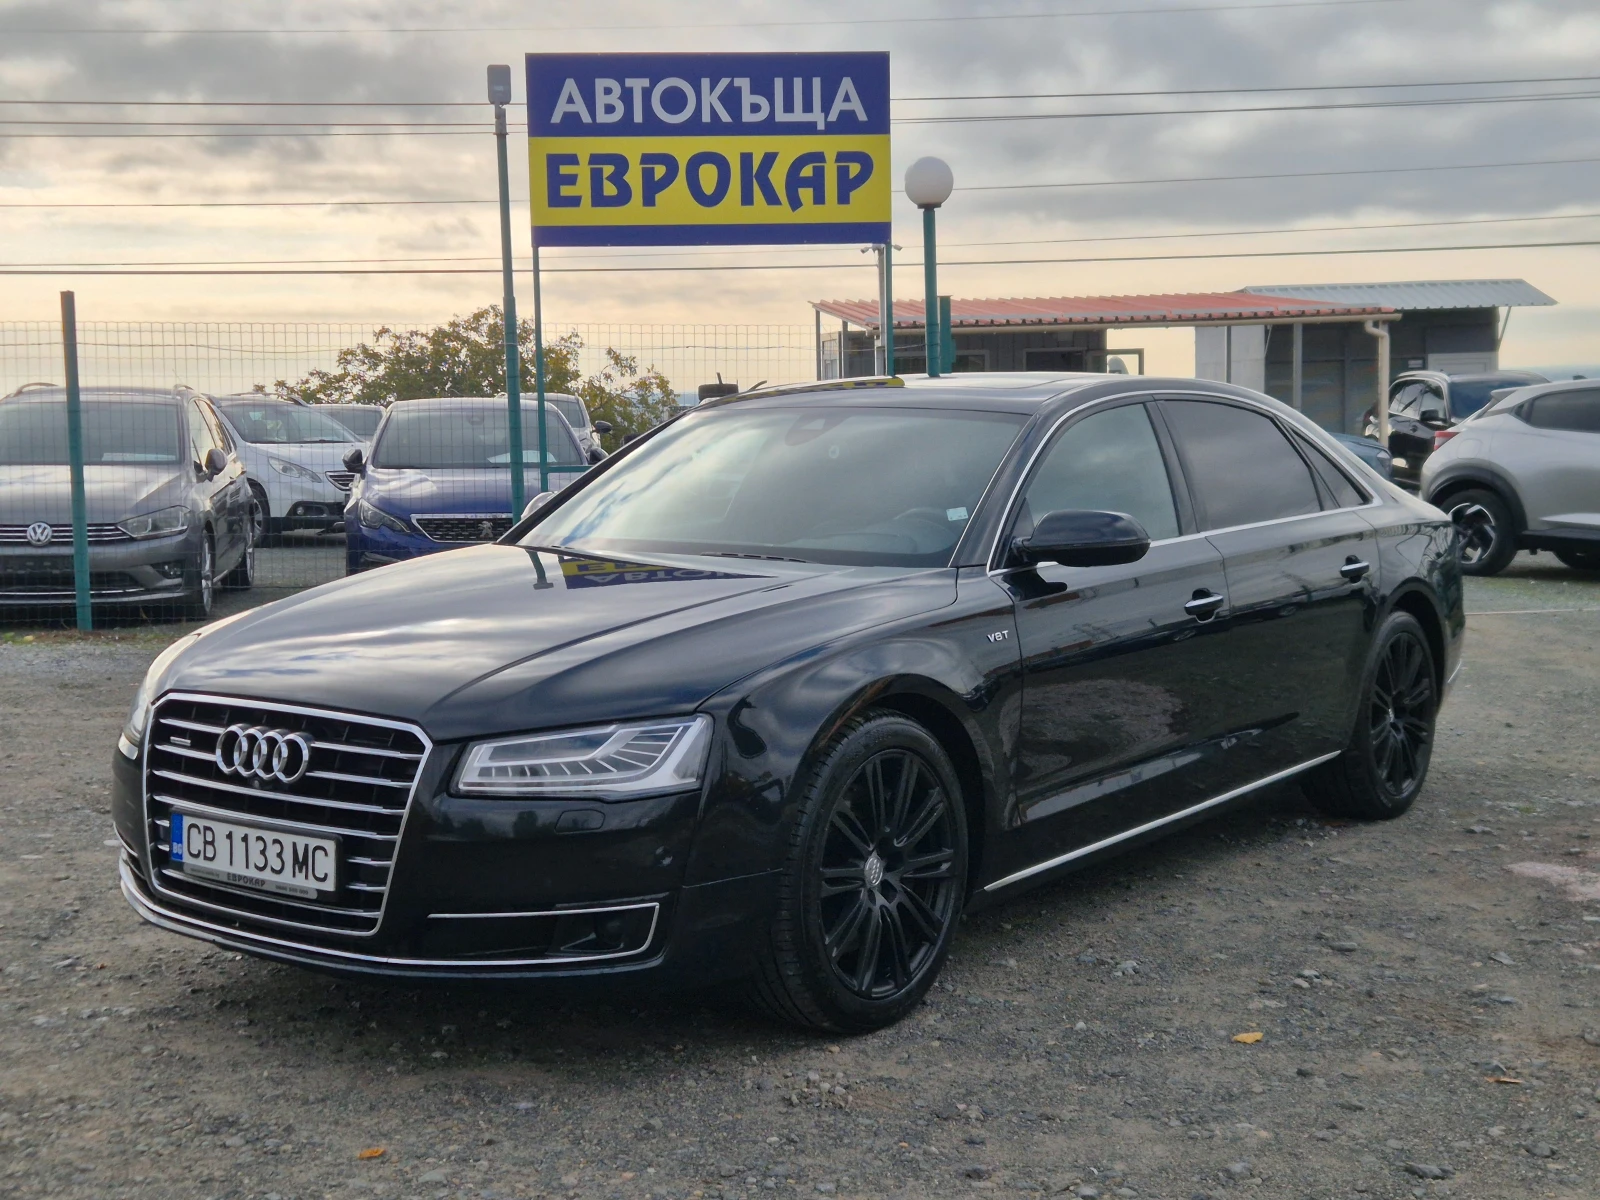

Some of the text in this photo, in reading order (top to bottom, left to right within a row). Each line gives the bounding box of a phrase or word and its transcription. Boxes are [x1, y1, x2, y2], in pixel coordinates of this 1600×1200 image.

[551, 77, 868, 130] АВТОКЪЩА
[546, 151, 874, 212] ЕВРОКАР
[987, 630, 1008, 643] V8T
[226, 831, 285, 874] 1133
[227, 873, 266, 888] ЕВРОКАР
